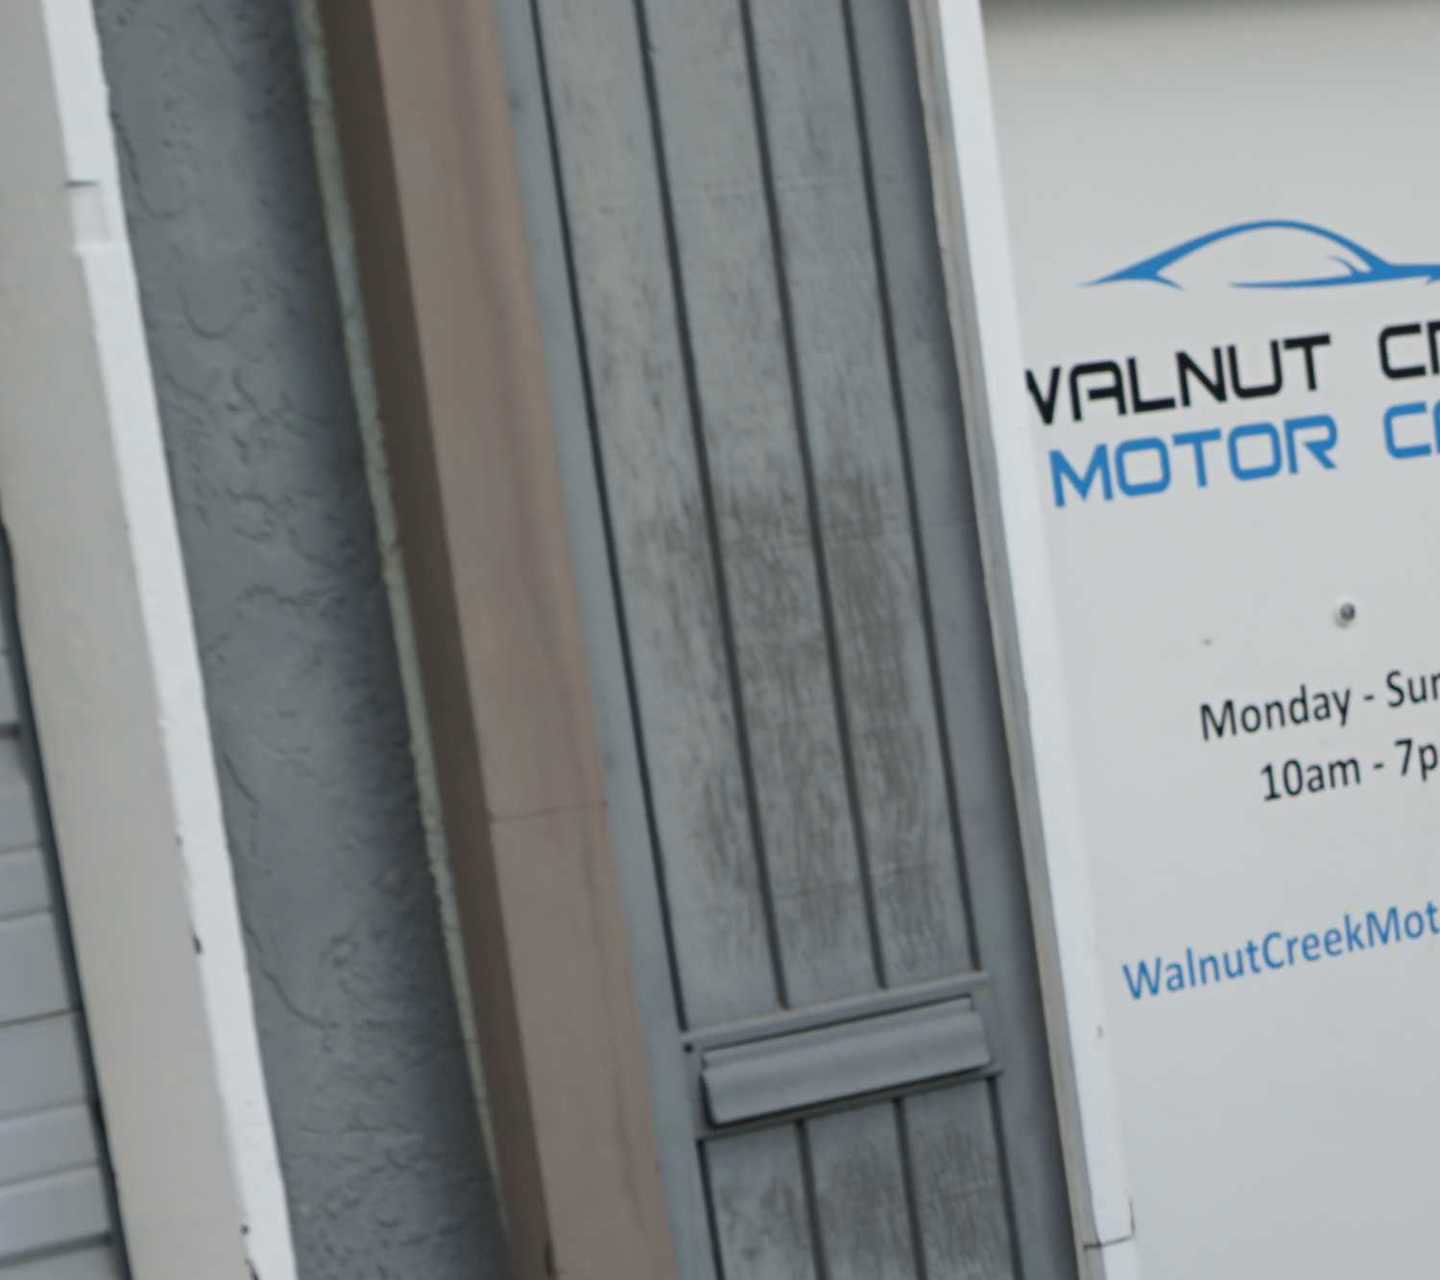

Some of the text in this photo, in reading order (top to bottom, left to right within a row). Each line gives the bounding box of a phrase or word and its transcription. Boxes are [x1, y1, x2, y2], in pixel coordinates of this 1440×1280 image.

[1047, 413, 1339, 509] MOTOR
[1199, 683, 1353, 743] Monday
[1260, 756, 1362, 803] 10am
